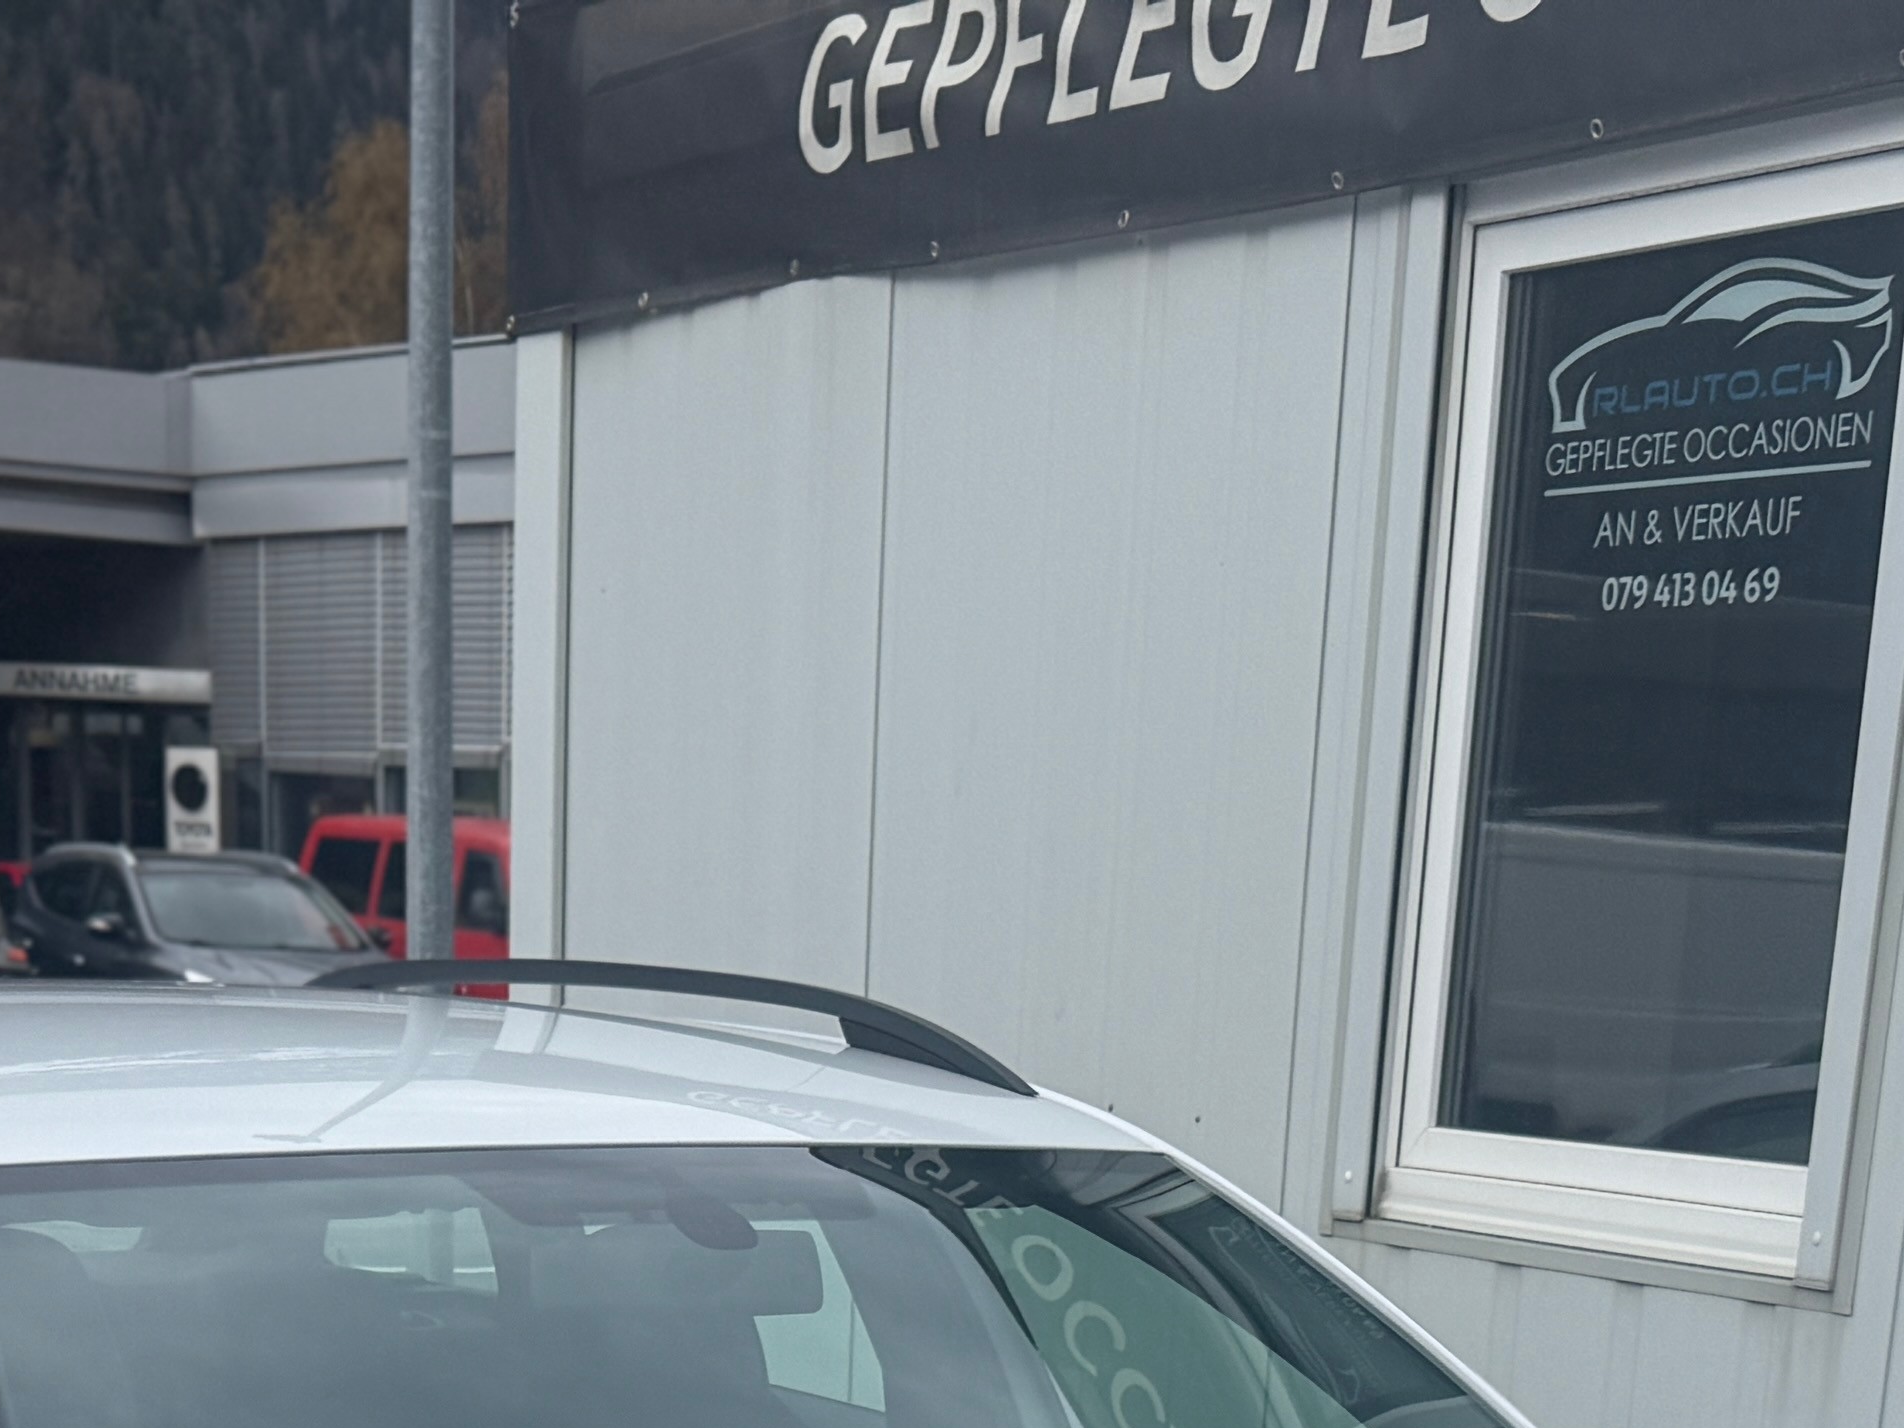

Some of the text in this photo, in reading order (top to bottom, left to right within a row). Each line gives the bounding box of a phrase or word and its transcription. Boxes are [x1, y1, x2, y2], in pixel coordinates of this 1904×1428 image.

[1592, 360, 1833, 417] RLAUTO.CH
[1545, 410, 1874, 476] GEPFLEGTE OCCASIONEN
[1593, 496, 1803, 548] AN & VERKAUF
[1601, 566, 1781, 611] 079 413 04 69
[14, 669, 138, 695] ANNAHME
